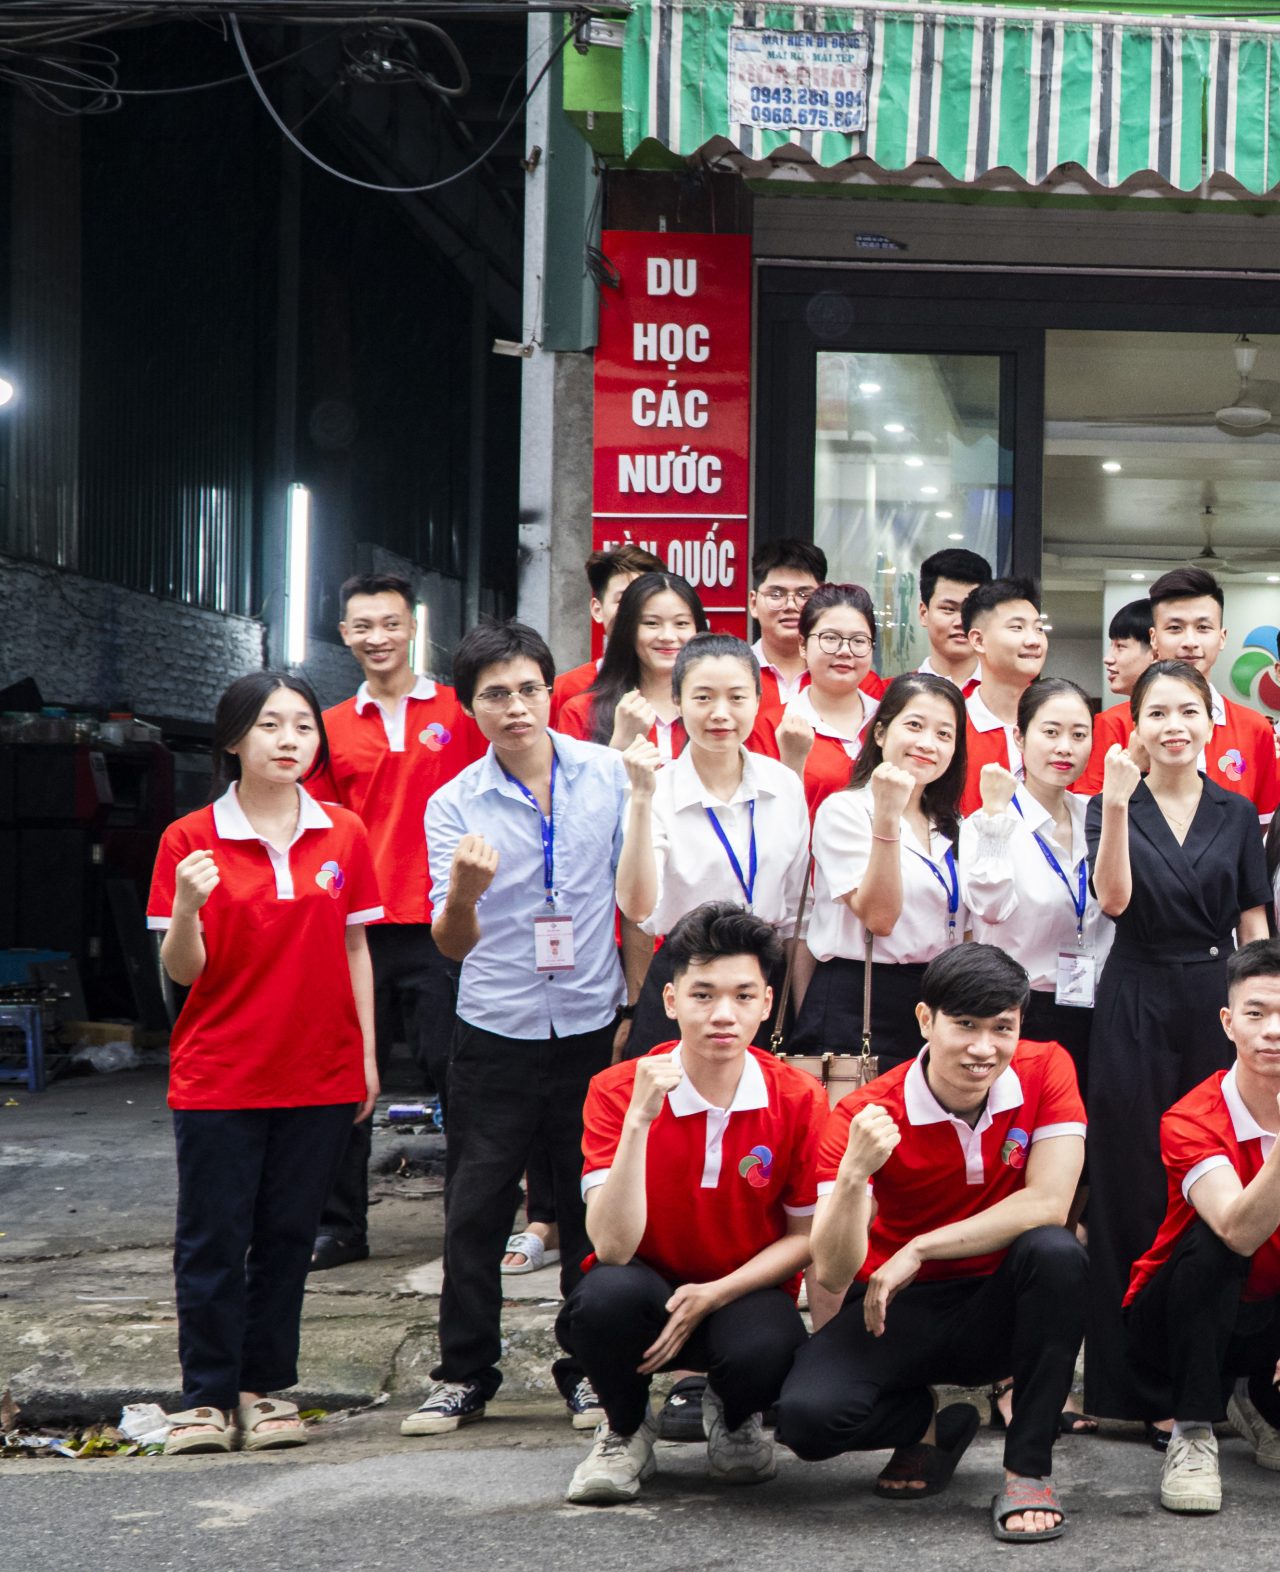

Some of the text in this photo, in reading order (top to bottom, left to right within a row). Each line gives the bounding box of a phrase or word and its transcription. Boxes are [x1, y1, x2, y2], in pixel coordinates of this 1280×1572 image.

[647, 257, 697, 297] DU
[633, 323, 710, 371] HỌC
[631, 379, 709, 429] CÁC
[618, 445, 722, 494] NƯỚC
